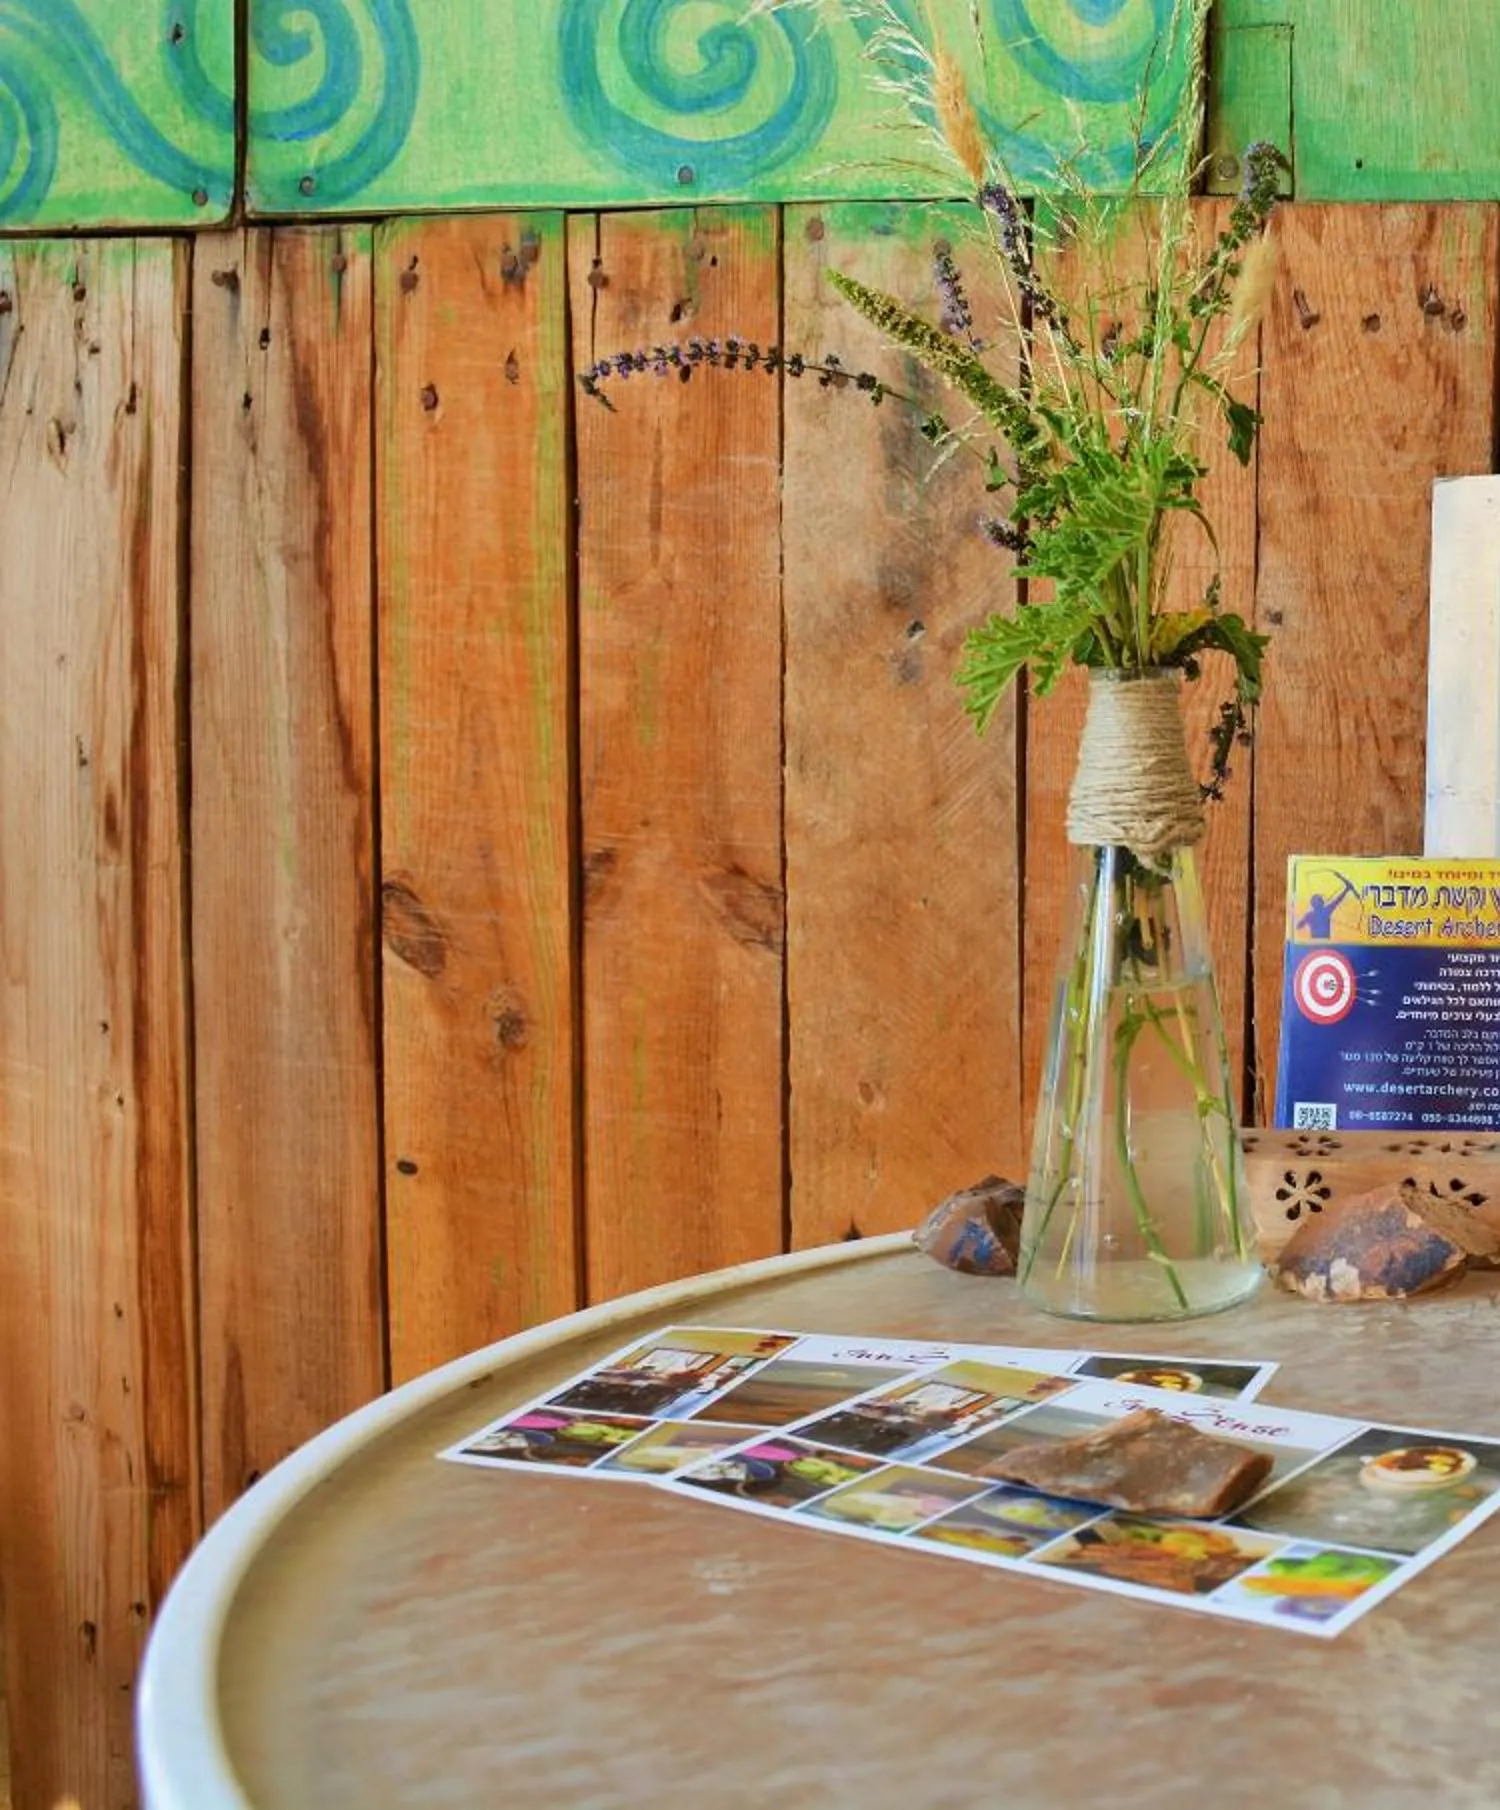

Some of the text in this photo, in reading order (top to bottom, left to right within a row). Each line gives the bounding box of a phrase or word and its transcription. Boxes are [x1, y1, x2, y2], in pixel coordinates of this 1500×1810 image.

[1361, 884, 1429, 909] מדברי
[1431, 884, 1487, 916] וקשת
[1367, 914, 1433, 937] Desert
[1447, 953, 1487, 965] מקצועי
[1446, 995, 1465, 1006] לכל
